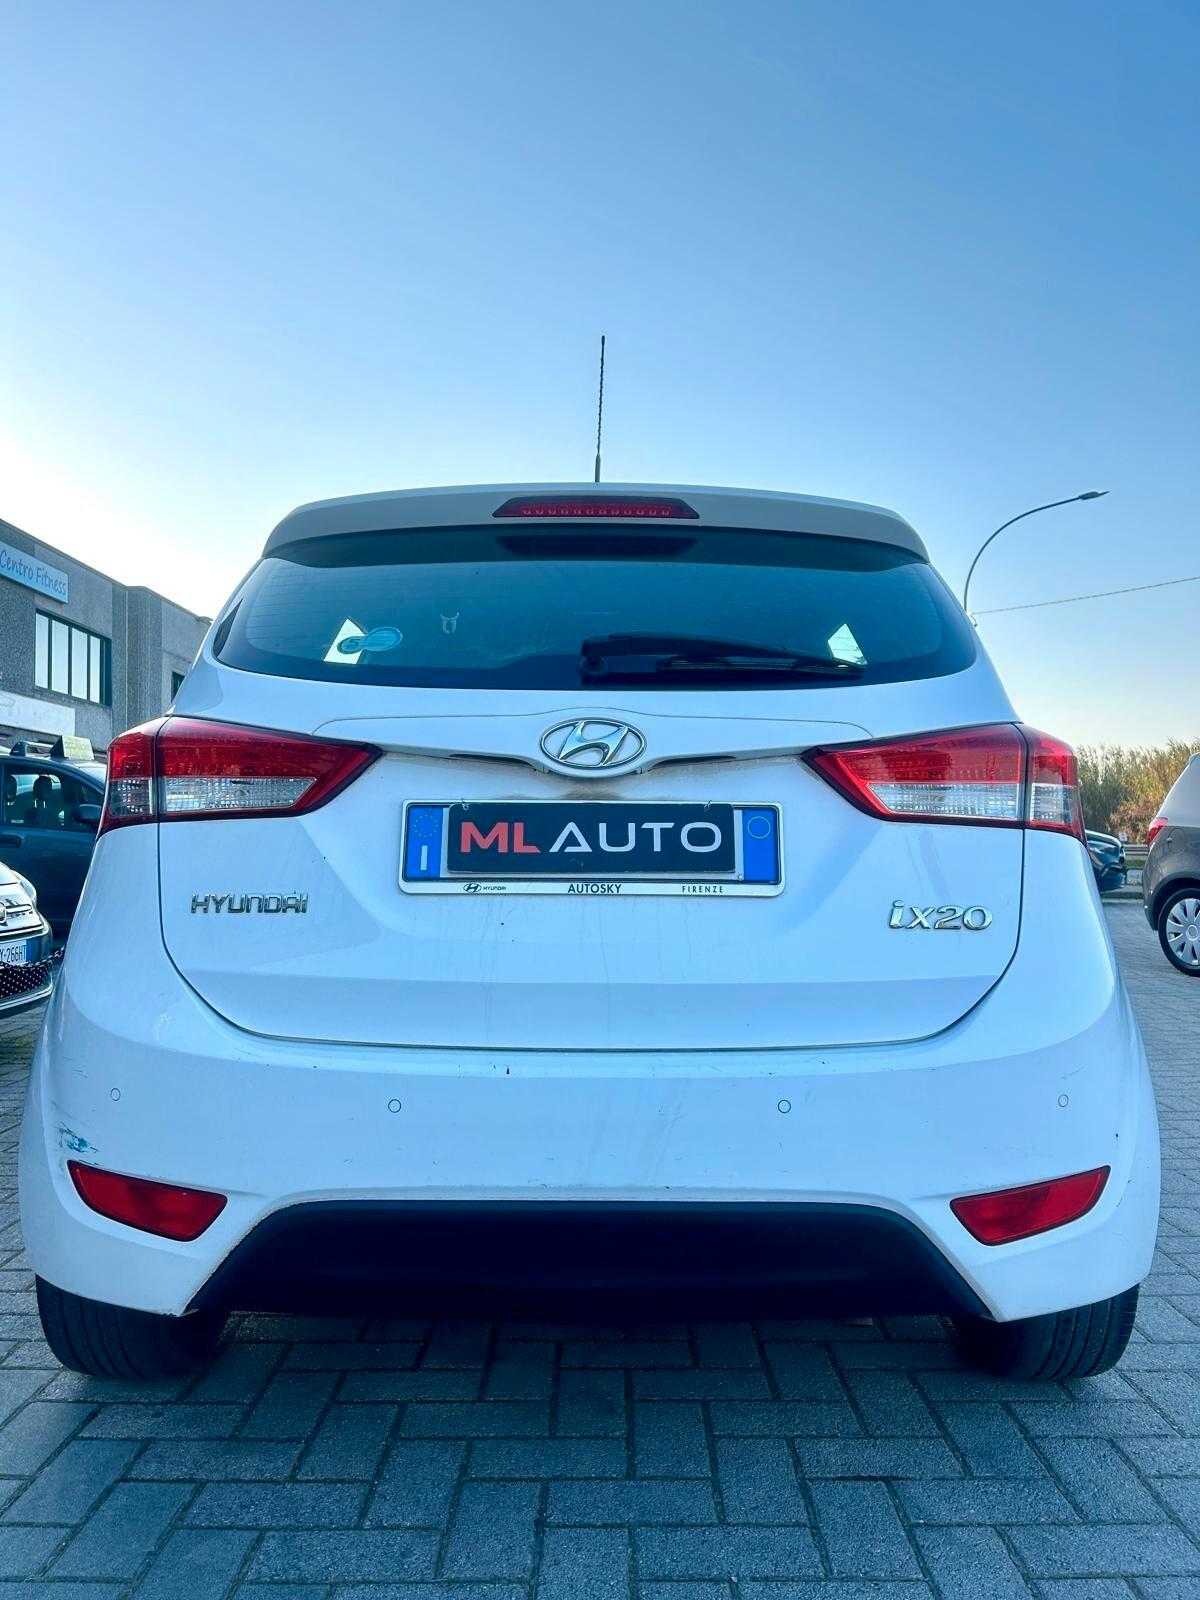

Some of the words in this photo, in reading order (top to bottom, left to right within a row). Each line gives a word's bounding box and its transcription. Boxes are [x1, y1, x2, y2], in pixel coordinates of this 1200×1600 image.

[0, 550, 34, 580] Centro
[36, 567, 66, 596] Fitness
[460, 821, 541, 853] ML
[549, 821, 722, 852] AUTO
[567, 883, 622, 894] AUTOSKY
[682, 885, 724, 894] FIRENZE
[191, 894, 308, 914] HYUNDAI
[888, 899, 993, 931] ix20
